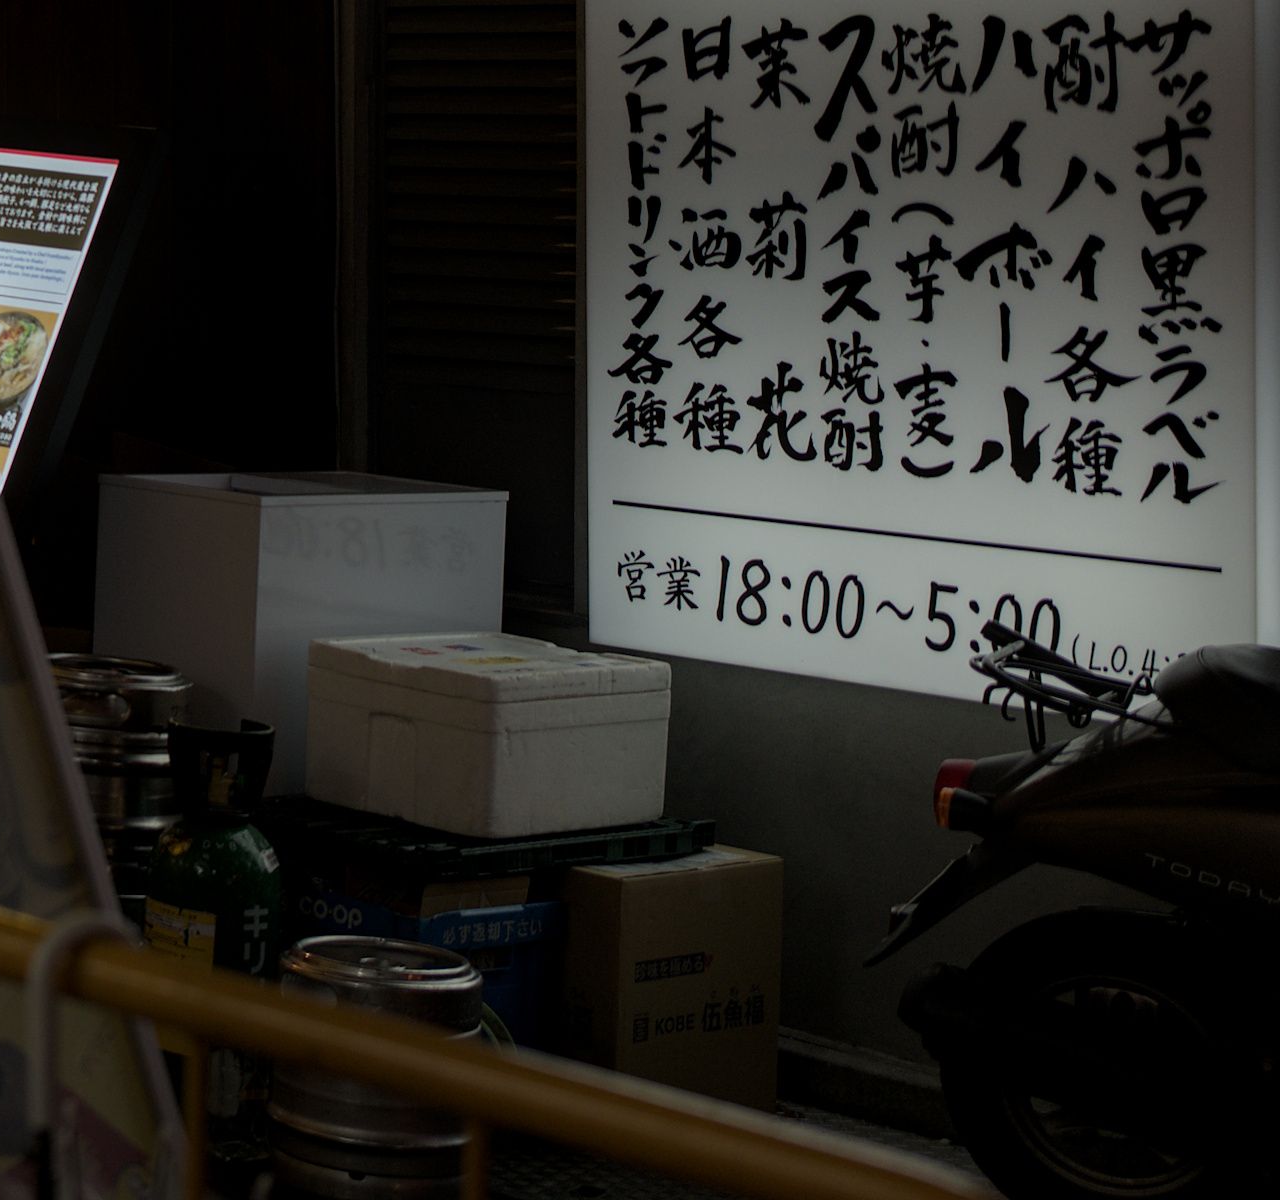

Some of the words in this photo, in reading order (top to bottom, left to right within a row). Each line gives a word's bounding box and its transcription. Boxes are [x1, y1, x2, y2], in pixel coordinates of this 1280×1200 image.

[608, 17, 674, 448] ソフトドリンク各種
[669, 16, 744, 456] 日本酒各種
[742, 18, 816, 462] 茉莉花
[814, 14, 883, 473] スパイス焼酎
[954, 15, 1052, 483] ハイボール
[1044, 11, 1142, 499] 酎ハイ各種
[1130, 8, 1228, 505] サッポロ黒ラベル
[616, 549, 702, 612] 営業
[243, 904, 270, 982] キリ
[441, 918, 544, 945] 必ず返却下さい
[655, 1012, 695, 1036] KOBE
[701, 992, 765, 1033] 伍魚福
